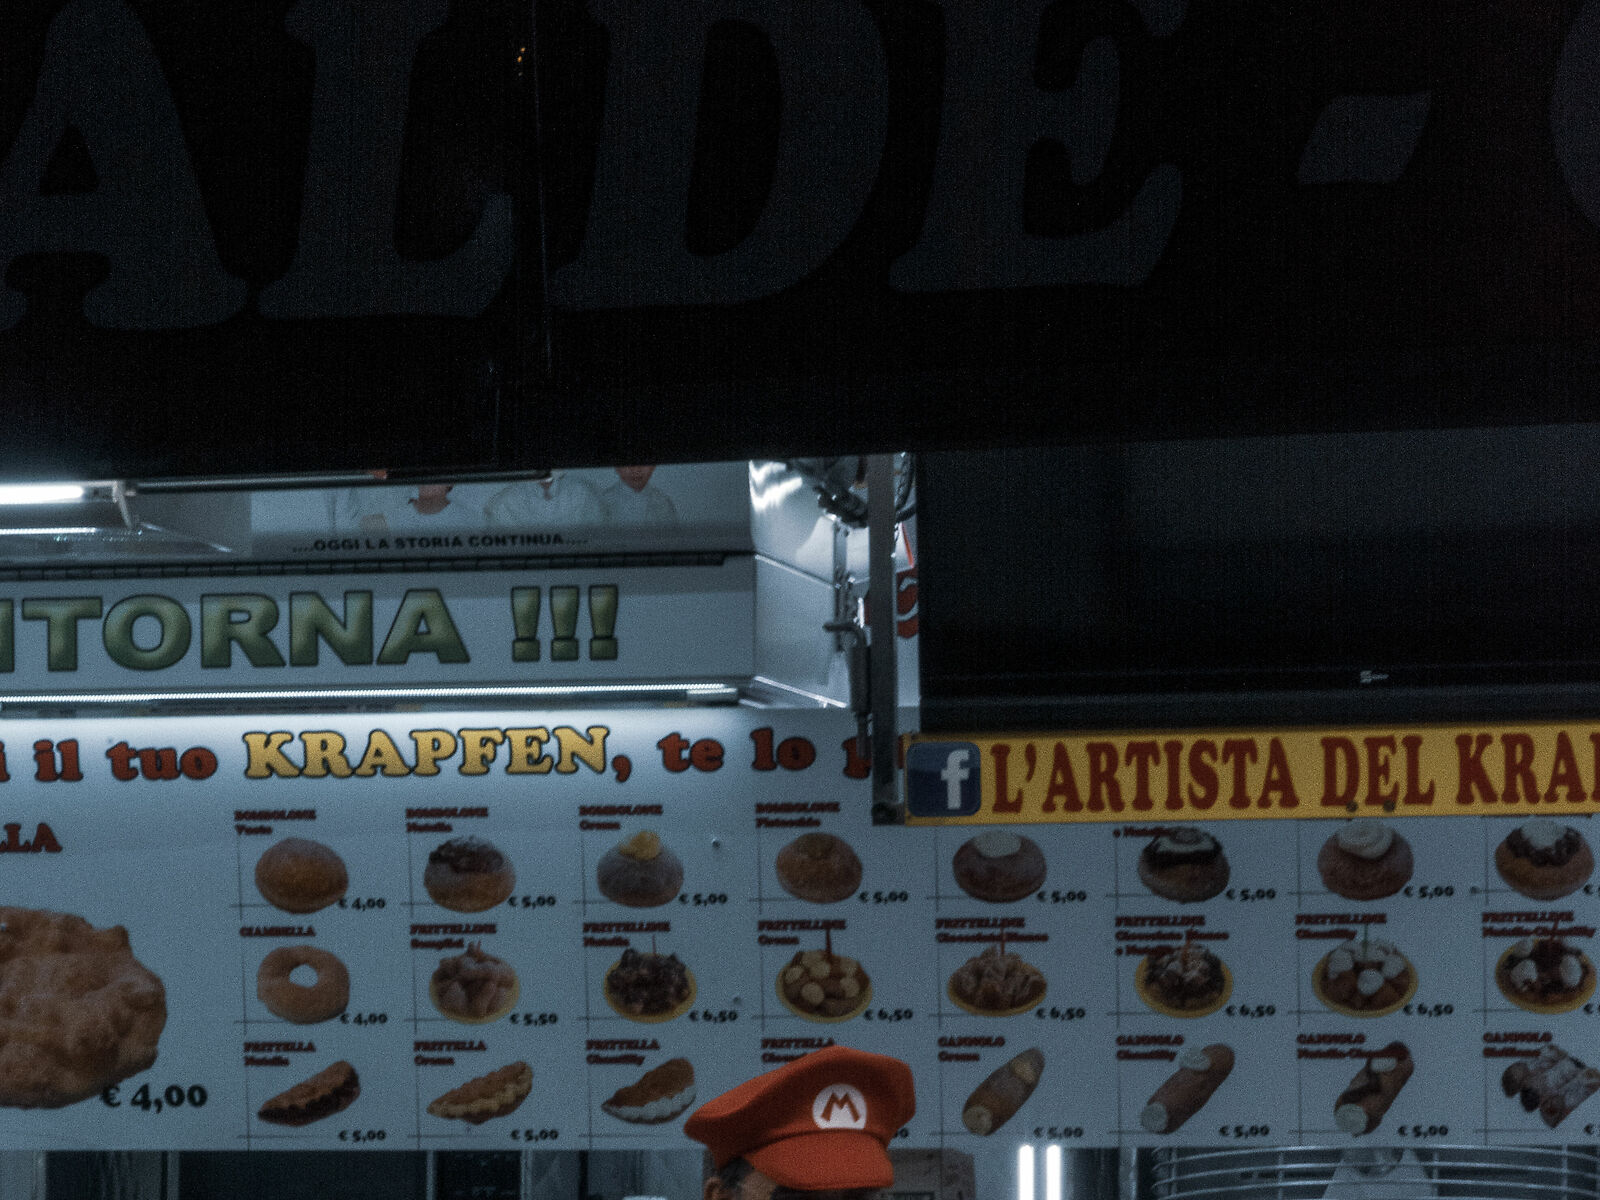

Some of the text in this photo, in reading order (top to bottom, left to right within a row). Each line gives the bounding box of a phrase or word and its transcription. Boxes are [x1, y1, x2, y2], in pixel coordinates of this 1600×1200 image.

[366, 538, 390, 549] LA
[395, 535, 462, 549] STORIA
[511, 585, 618, 661] !!!
[34, 739, 84, 783] il
[106, 741, 218, 780] tuo
[243, 725, 631, 784] KRAPFEN,
[658, 729, 724, 774] te
[750, 727, 816, 772] lo
[990, 737, 1299, 814] L'ARTISTA
[1320, 733, 1435, 810] DEL
[0, 822, 63, 853] LA
[101, 1084, 208, 1114] € 4,00
[821, 1092, 862, 1122] M
